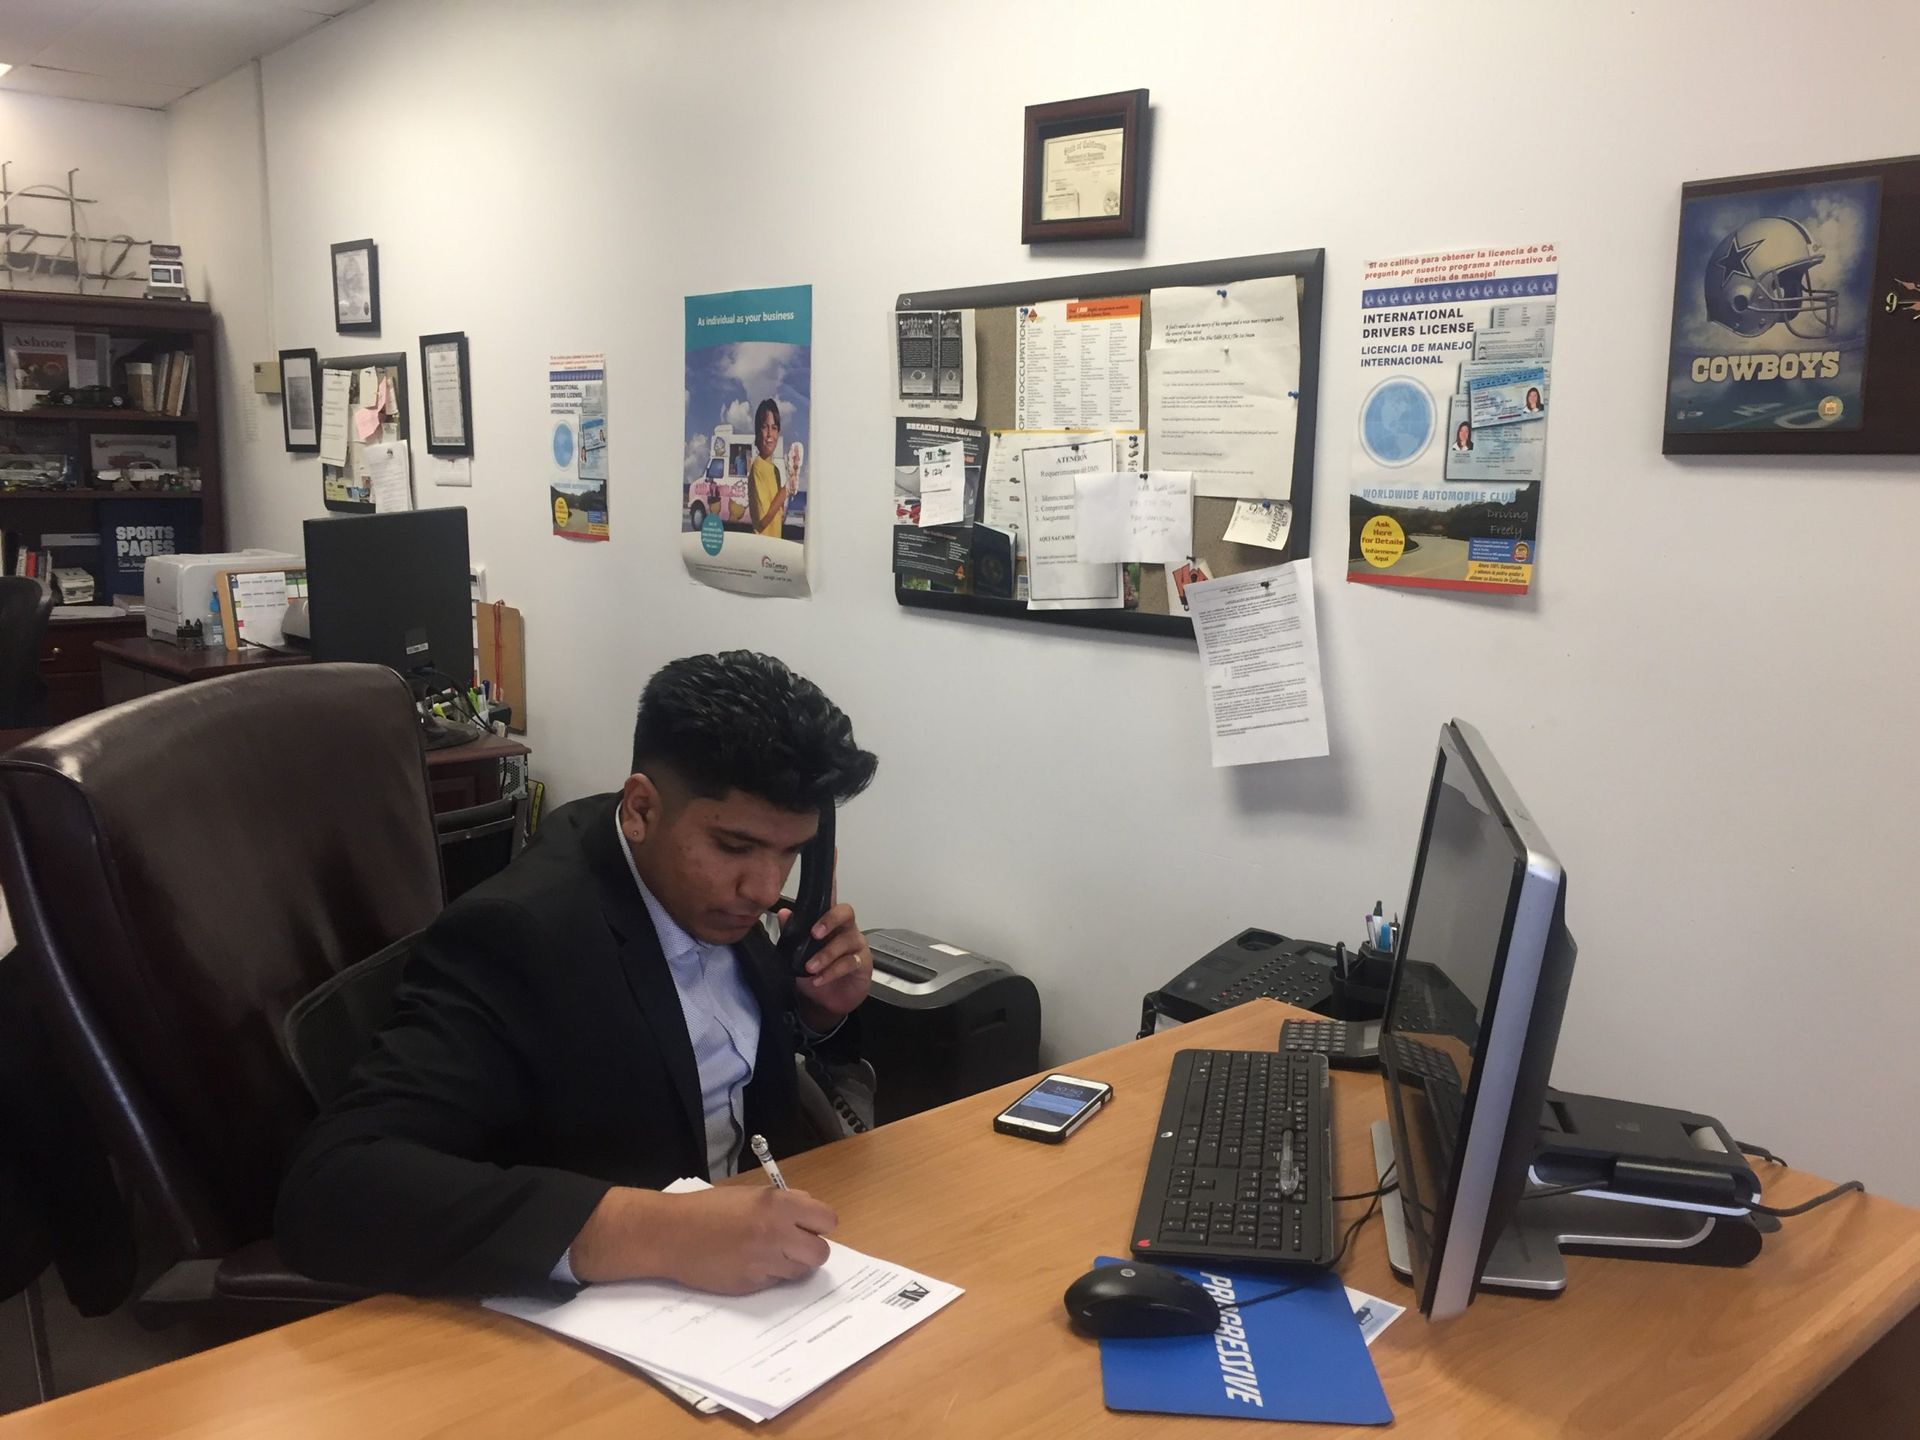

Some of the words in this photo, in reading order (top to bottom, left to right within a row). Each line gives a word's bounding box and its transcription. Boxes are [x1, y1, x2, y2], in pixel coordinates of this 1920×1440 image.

[1421, 256, 1439, 265] para
[1441, 252, 1474, 262] obtener
[1488, 248, 1524, 257] licencia
[1527, 246, 1538, 254] de
[1541, 244, 1554, 252] CA
[1401, 268, 1414, 277] por
[1416, 265, 1447, 274] nuestro
[1449, 261, 1490, 272] programa
[1493, 256, 1543, 267] alternativo
[1546, 254, 1558, 262] de
[1414, 275, 1447, 284] licencia
[1448, 273, 1459, 281] de
[1885, 292, 1898, 313] 9
[697, 317, 705, 326] As
[706, 313, 735, 325] individual
[744, 314, 761, 325] your
[762, 311, 794, 321] business
[1363, 308, 1464, 324] INTERNATIONAL
[1362, 326, 1415, 339] DRIVERS
[1420, 322, 1474, 335] LICENSE
[1361, 344, 1408, 355] LICENCIA
[1411, 343, 1425, 352] DE
[1428, 341, 1473, 352] MANEJO
[1360, 355, 1443, 367] INTERNACIONAL
[1691, 351, 1840, 383] COWBOYS
[1362, 488, 1419, 500] WORLDWIDE
[1422, 490, 1486, 501] AUTOMOBILE
[1490, 491, 1517, 502] CLUB
[1487, 509, 1529, 522] Driving
[115, 526, 175, 540] SPORTS
[1490, 525, 1523, 538] Freely
[1375, 537, 1404, 545] Details
[116, 540, 176, 557] PAGES
